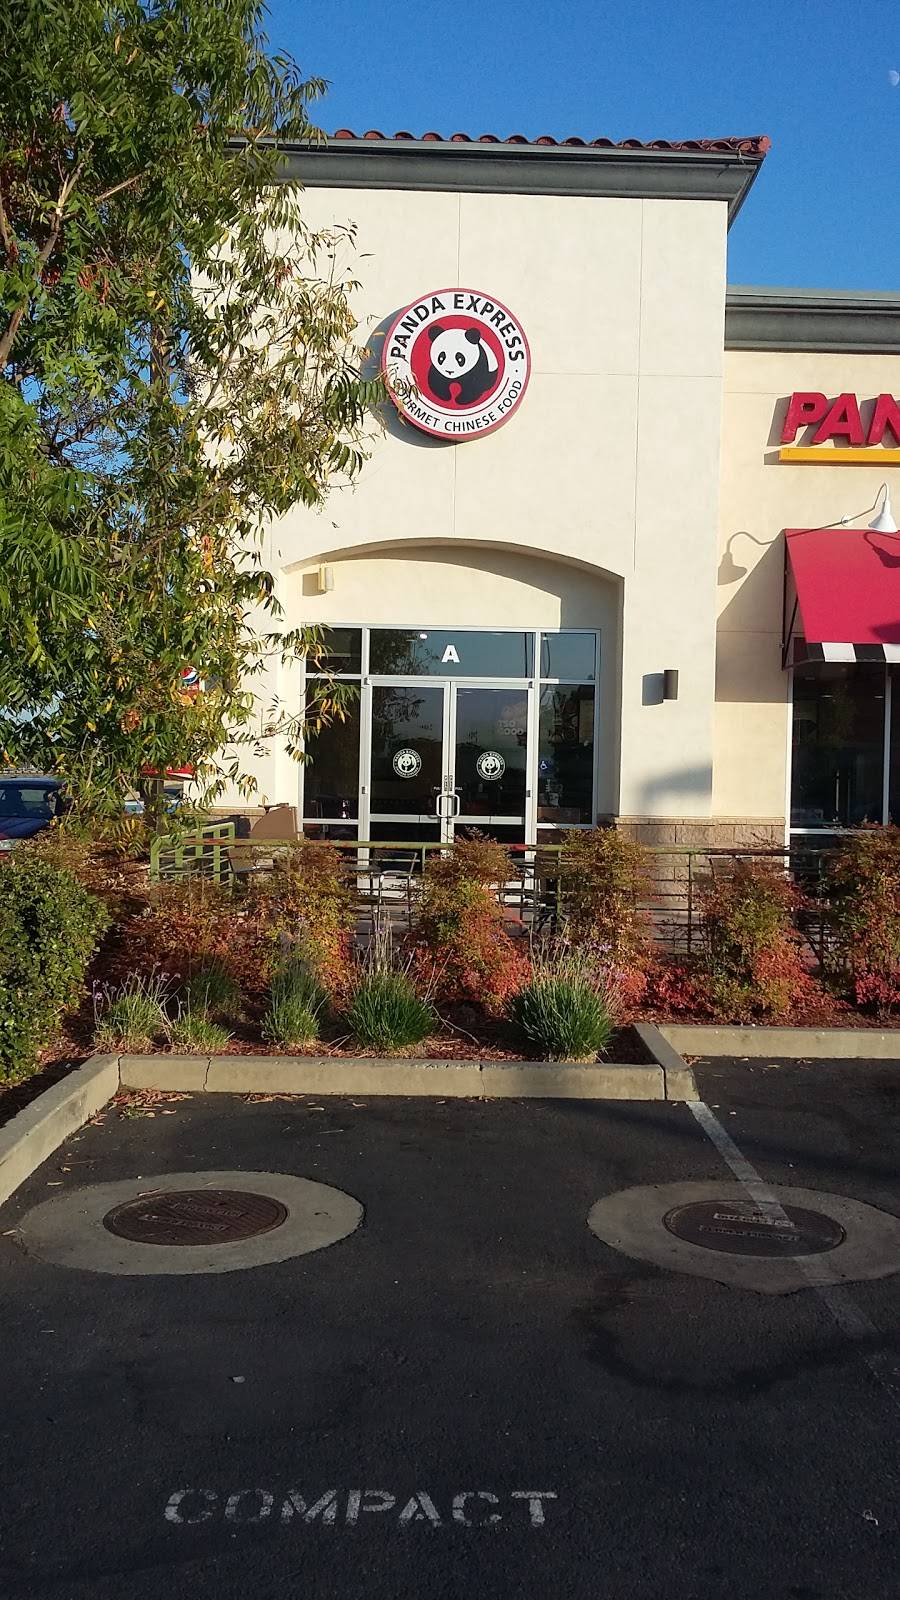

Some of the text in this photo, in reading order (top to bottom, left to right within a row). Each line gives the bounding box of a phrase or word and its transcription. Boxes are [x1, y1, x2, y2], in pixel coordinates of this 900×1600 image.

[390, 294, 524, 361] PANDA EXPRESS
[444, 411, 497, 432] CHINESE
[498, 380, 522, 414] FOOD
[441, 645, 460, 662] A
[164, 1488, 557, 1527] COMPACT
